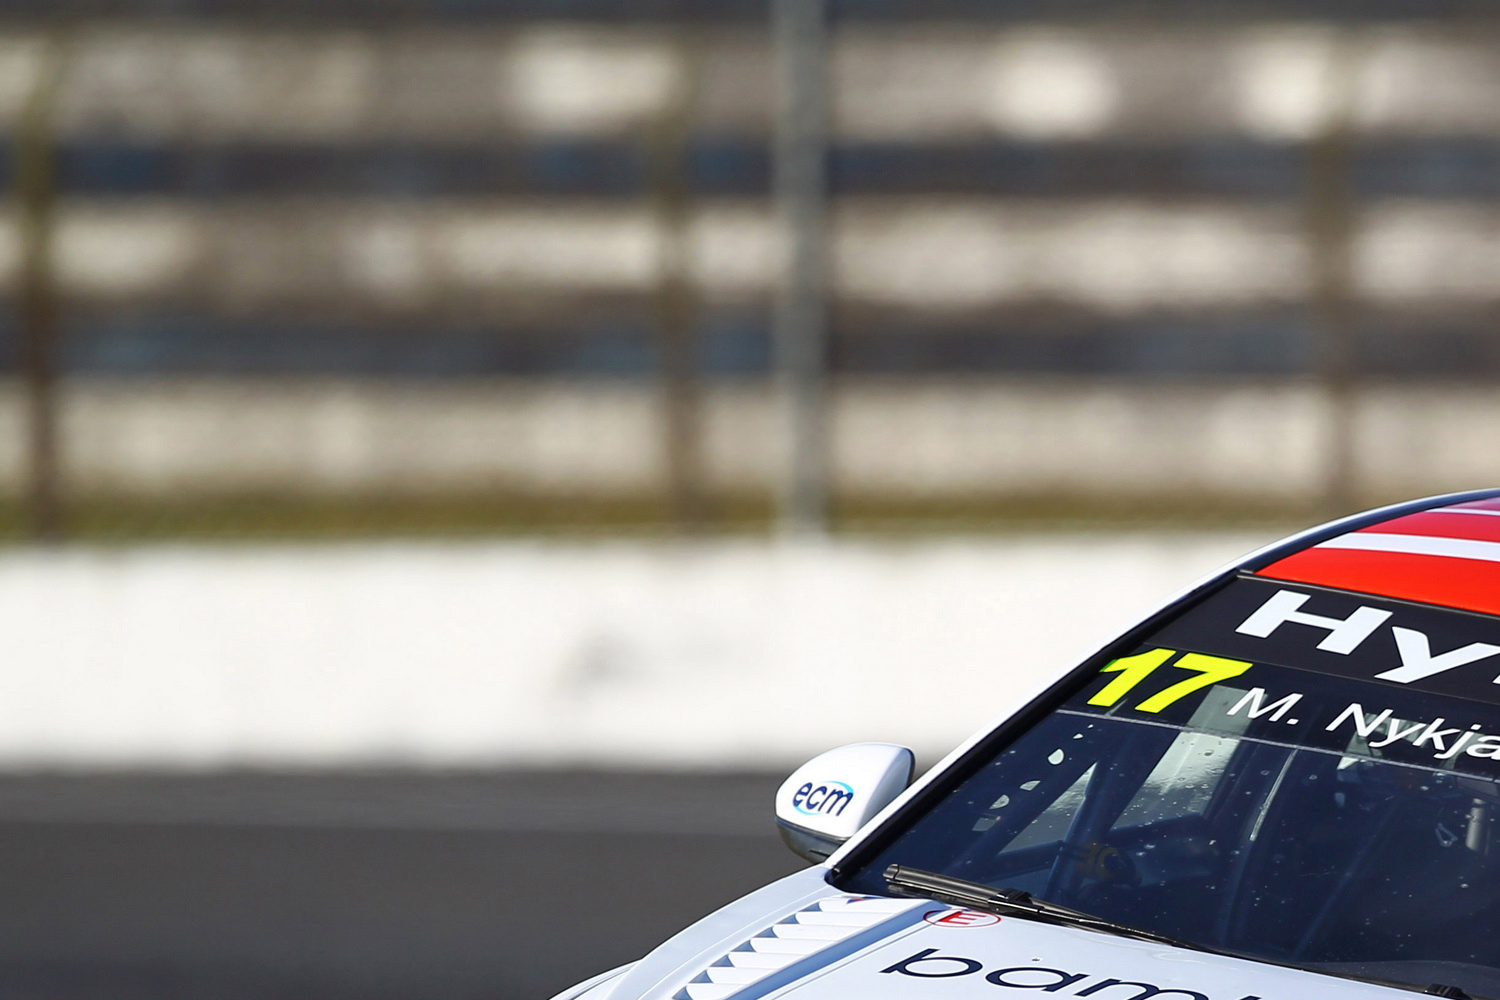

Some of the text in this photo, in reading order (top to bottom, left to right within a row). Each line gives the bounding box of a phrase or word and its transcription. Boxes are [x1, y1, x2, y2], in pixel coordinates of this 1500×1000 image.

[1085, 646, 1253, 714] 17
[1227, 687, 1298, 725] M.
[792, 782, 854, 816] ecm
